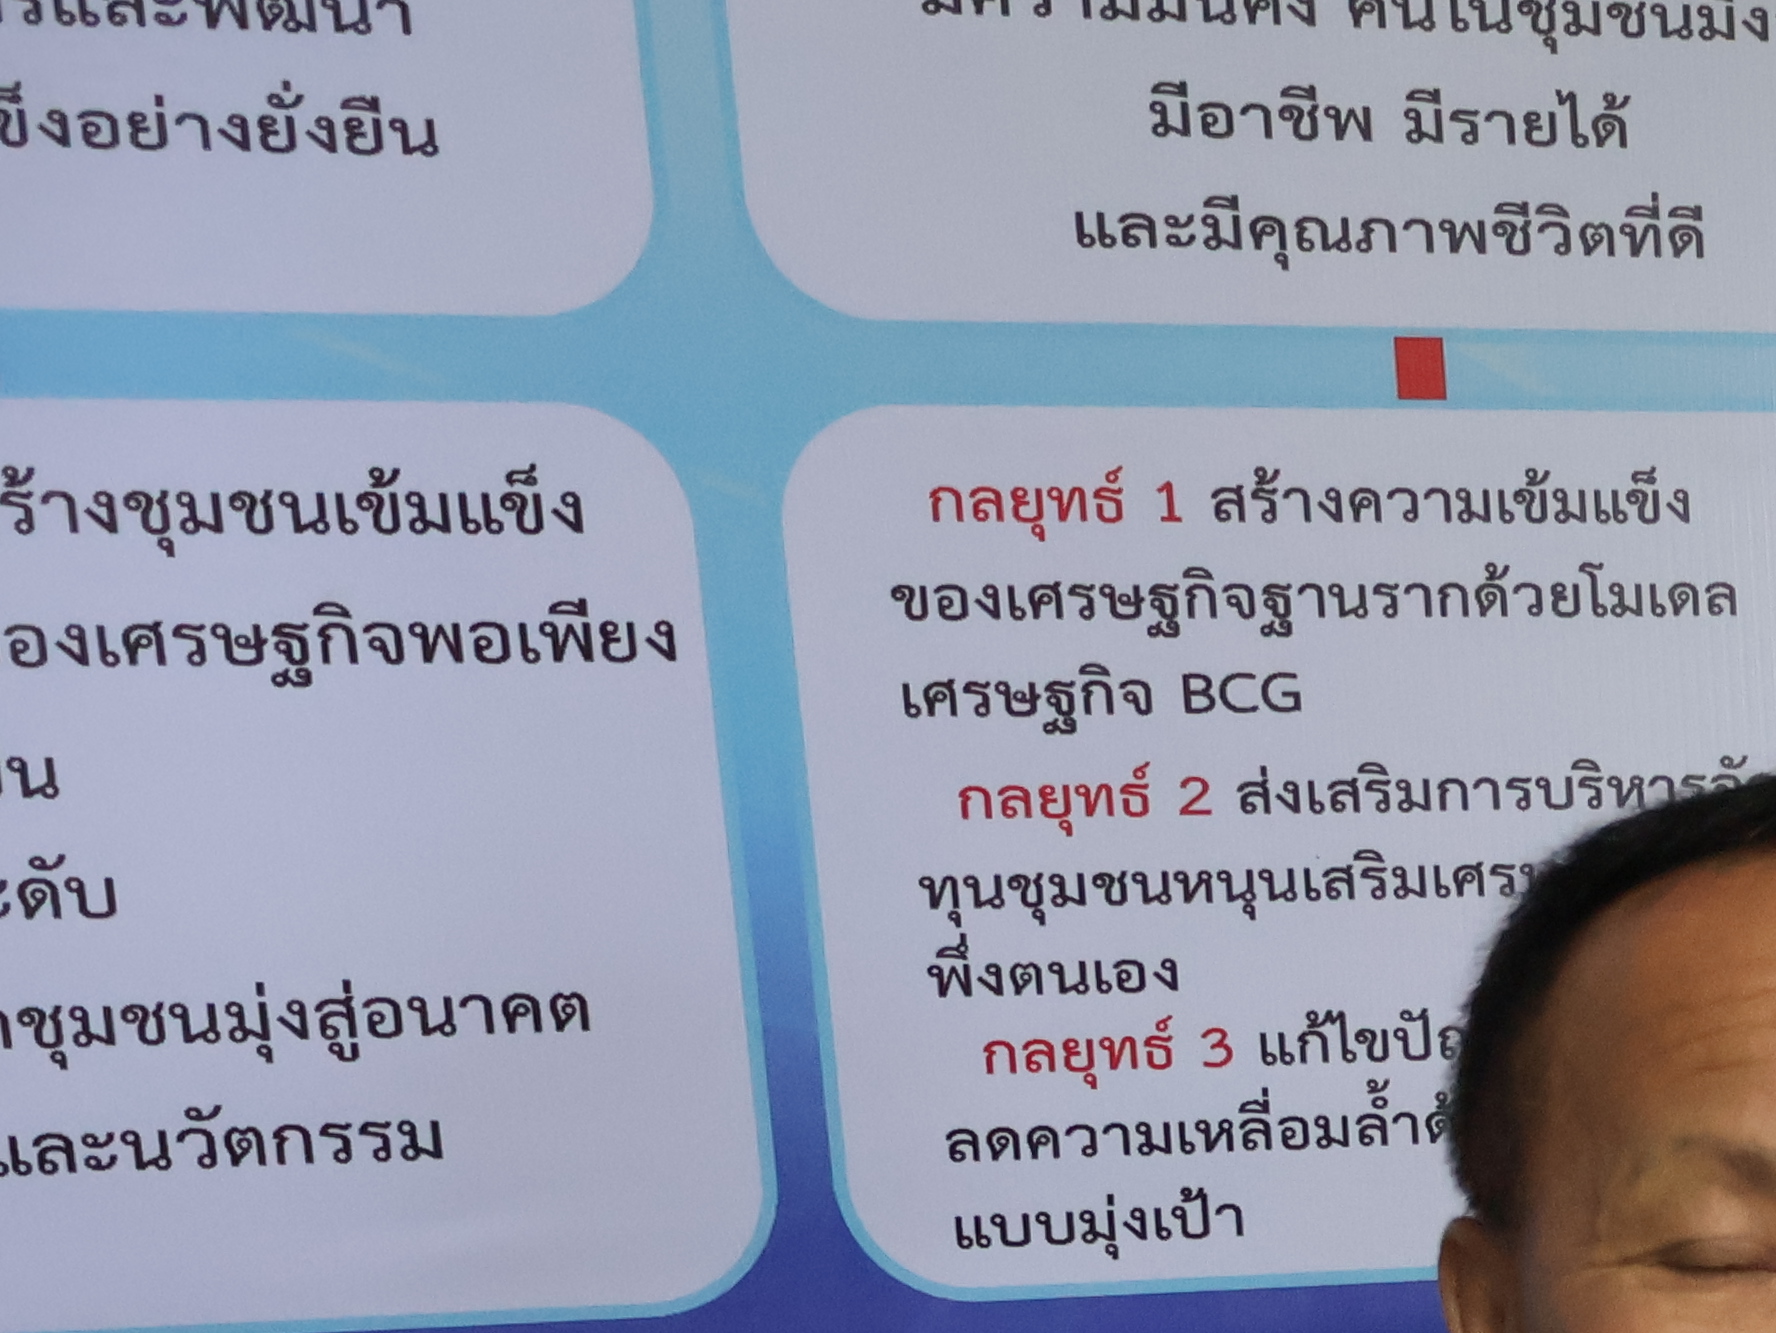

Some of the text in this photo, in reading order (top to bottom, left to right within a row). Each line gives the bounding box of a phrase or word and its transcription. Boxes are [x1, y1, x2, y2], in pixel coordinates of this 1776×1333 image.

[1149, 81, 1631, 148] มีอาชีพ มีรายได้
[1075, 192, 1704, 271] และมีคุณภาพชีวิตที่ดี
[929, 466, 1690, 542] กลยุทธ์ 1 สร้างความเข้มแข็ง
[891, 562, 1736, 638] ของเศรษฐกิจฐานรากด้วยโมเดล
[4, 598, 676, 687] องเศรษฐกิจพอเพียง
[902, 663, 1301, 734] เศรษฐกิจ BCG
[959, 762, 1150, 837] กลยุทธ์
[1180, 777, 1212, 815] 2
[927, 933, 1178, 998] พึ่งตนเอง
[983, 1015, 1173, 1089] กลยุทธ์
[1201, 1028, 1233, 1068] 3
[955, 1187, 1243, 1260] แบบมุ่งเป้า
